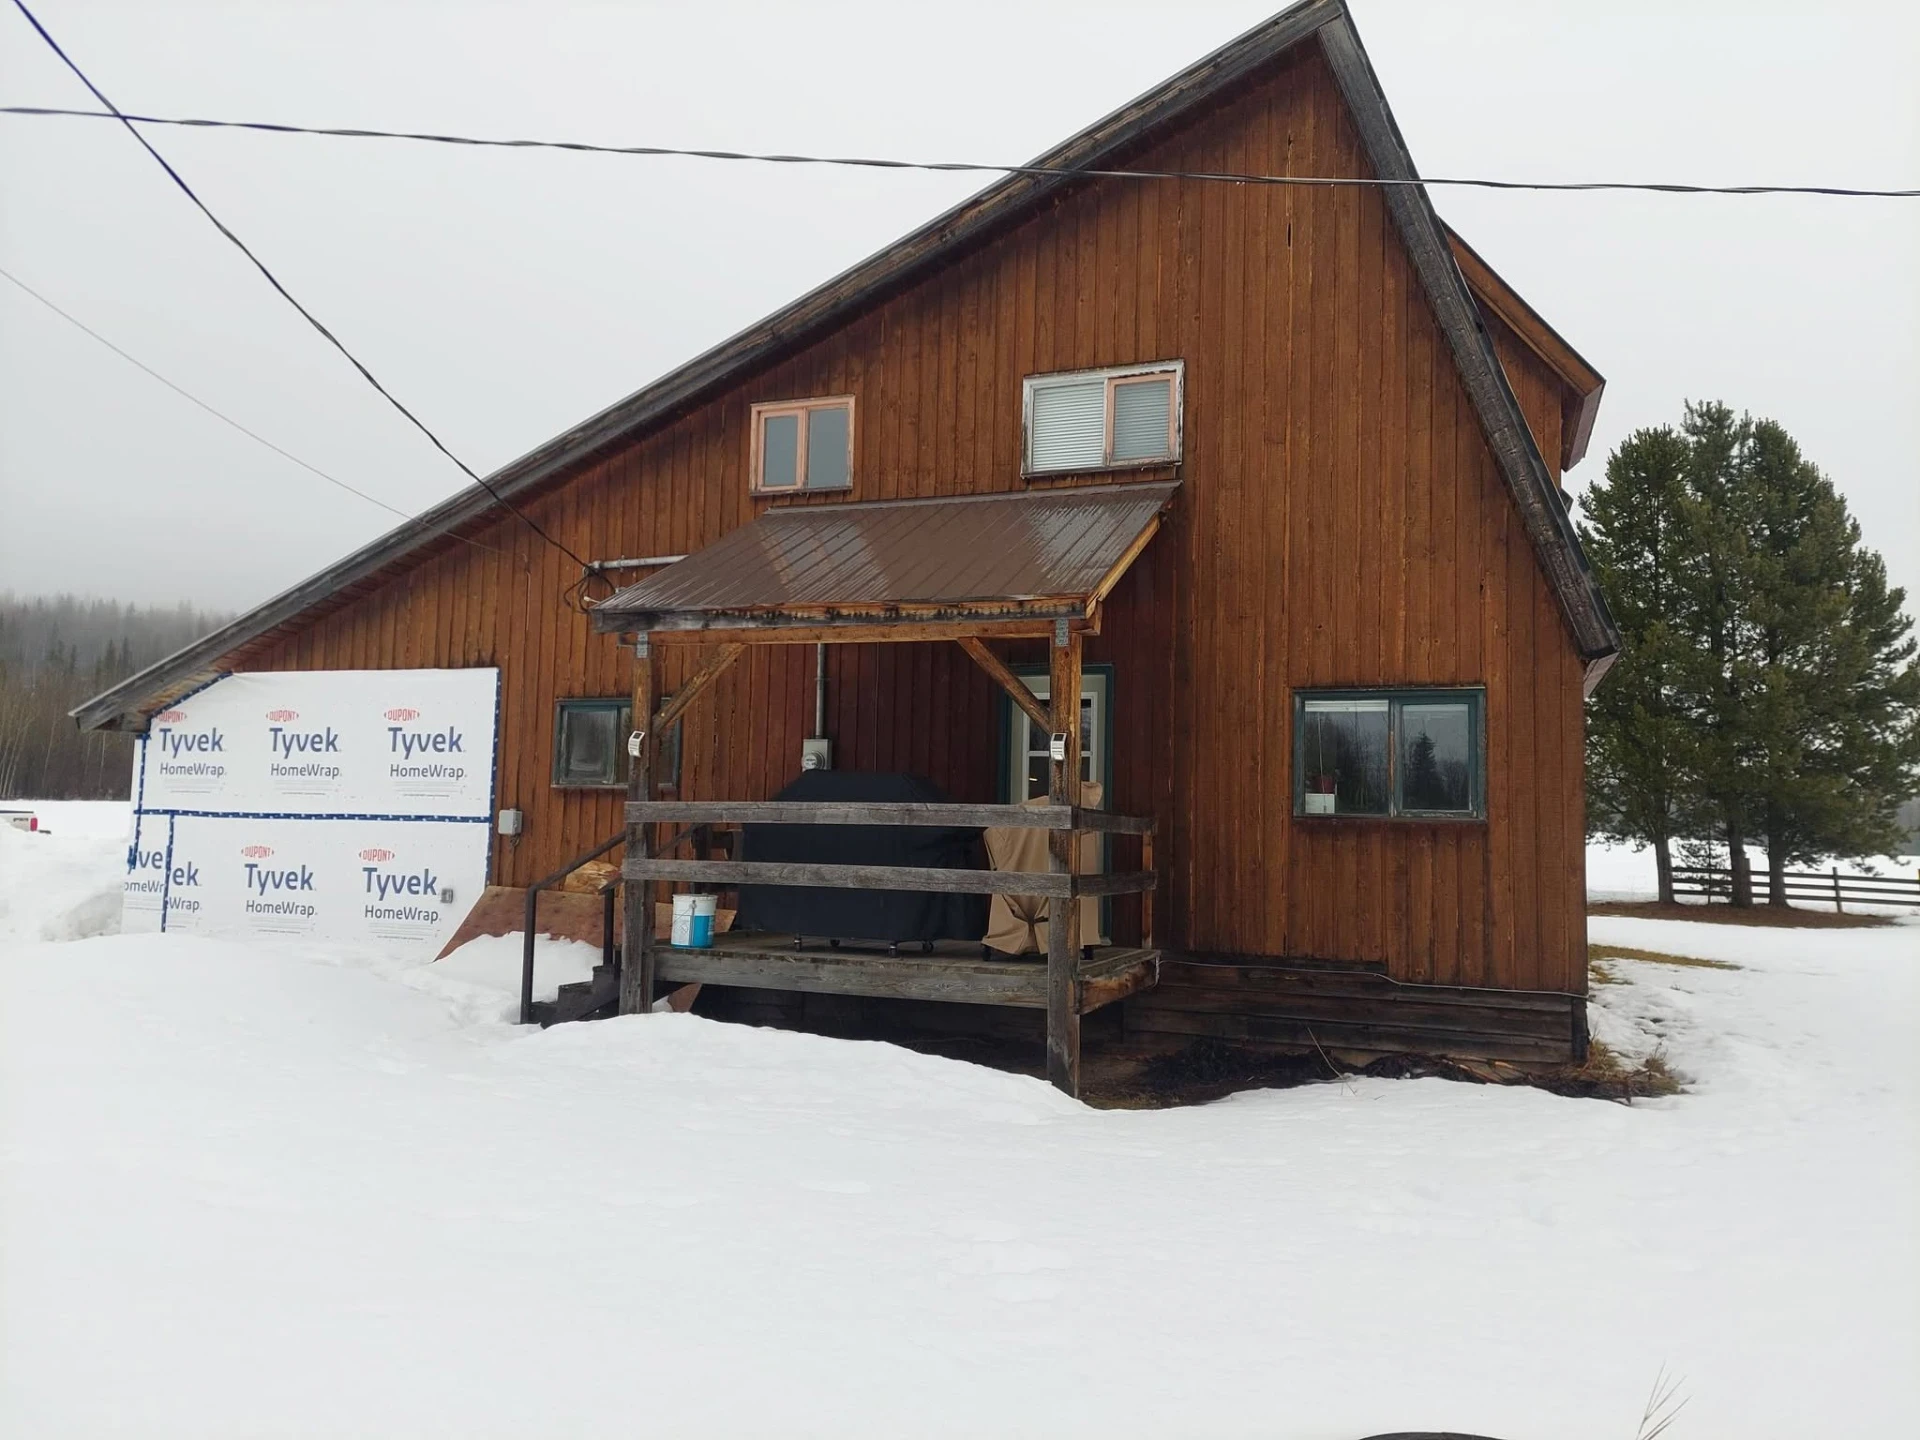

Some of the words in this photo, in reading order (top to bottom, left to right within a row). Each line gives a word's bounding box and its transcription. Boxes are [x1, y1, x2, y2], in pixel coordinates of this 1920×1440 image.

[269, 709, 296, 722] DUPONT
[387, 708, 417, 721] DUPONT
[159, 727, 224, 759] Tyvek
[269, 727, 339, 759] Tyvek
[387, 726, 463, 760] Tyvek
[159, 762, 225, 778] HomeWrap
[270, 763, 340, 780] HomeWrap
[389, 764, 465, 780] HomeWrap
[244, 845, 271, 858] DUPONT
[362, 848, 391, 862] DUPONT
[244, 863, 314, 896] Tyvek
[362, 867, 437, 901] Tyvek
[245, 900, 315, 918] HomeWrap
[364, 905, 439, 924] HomeWrap
